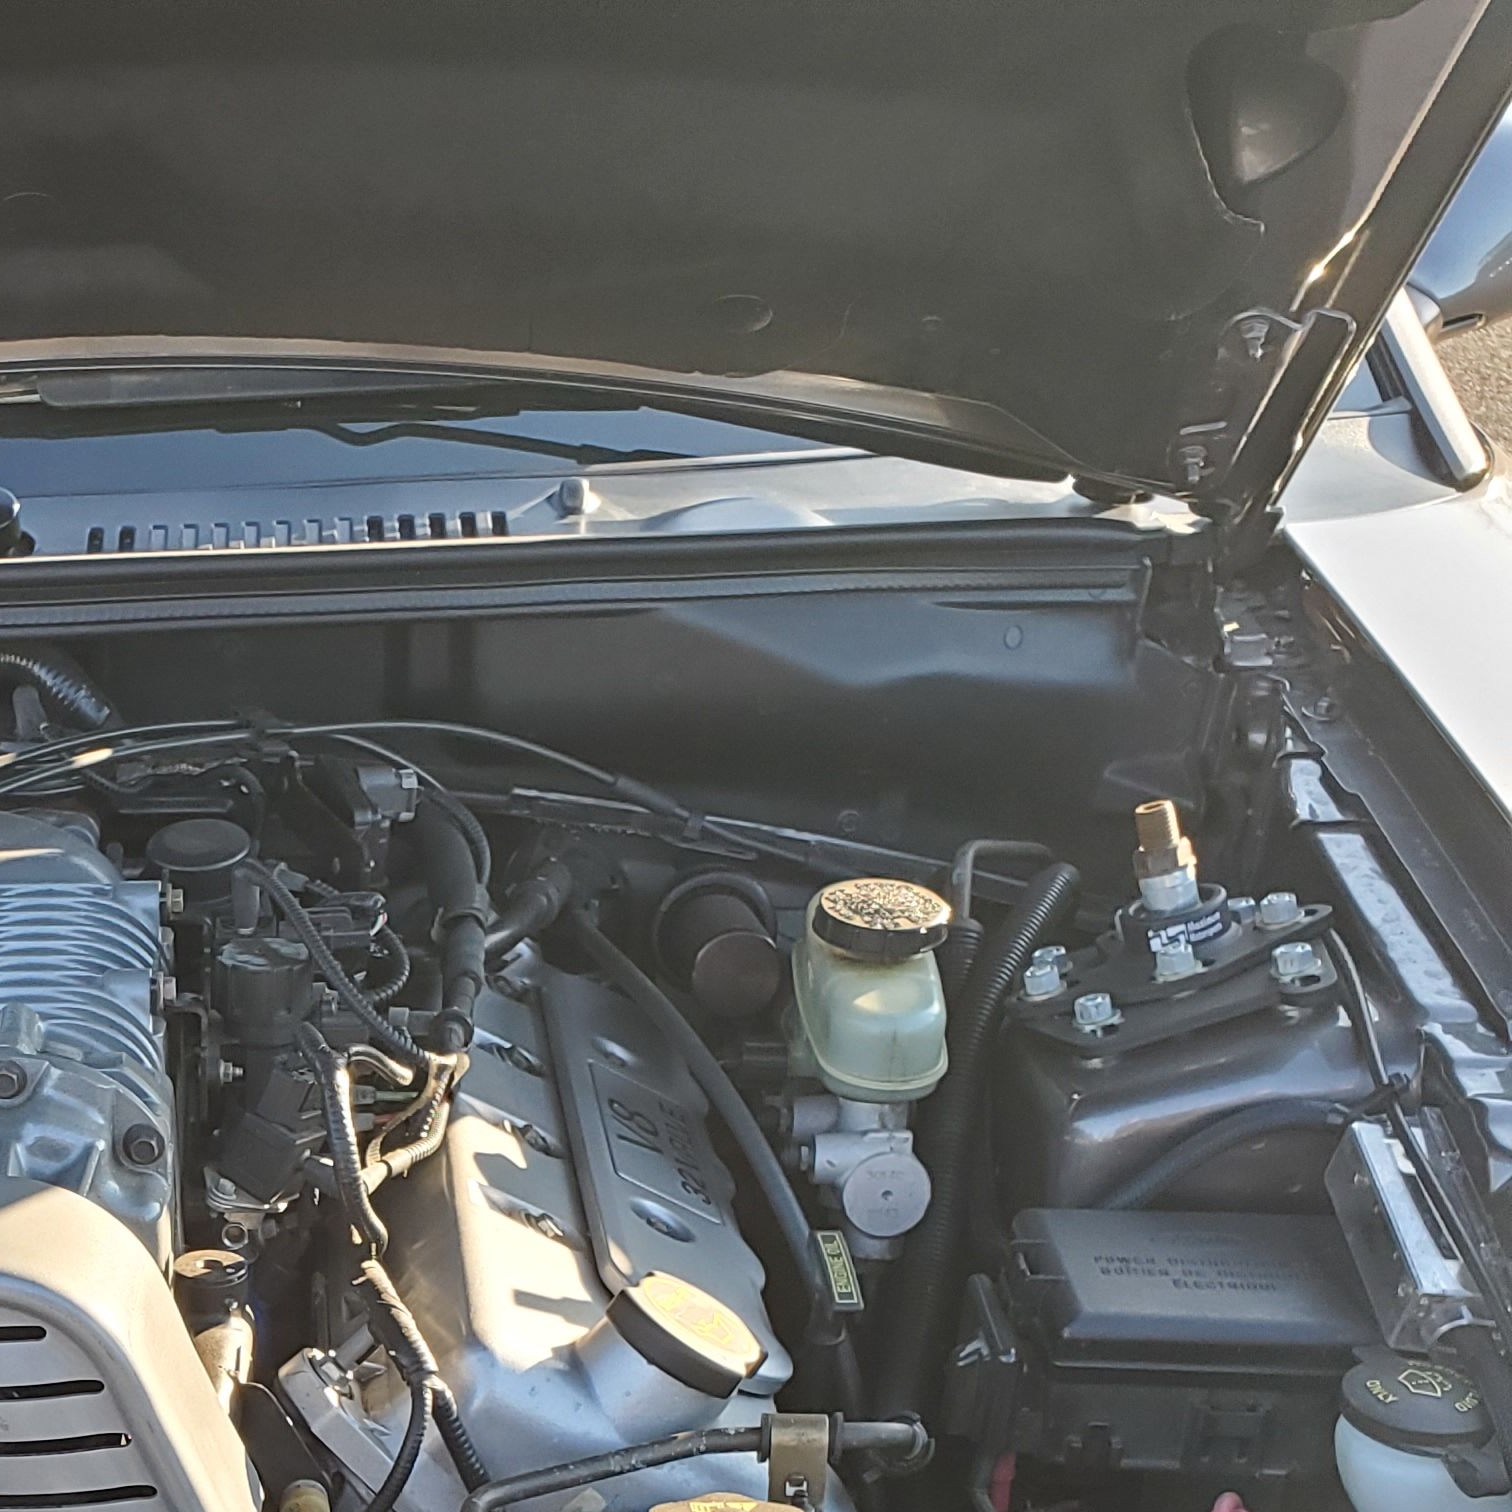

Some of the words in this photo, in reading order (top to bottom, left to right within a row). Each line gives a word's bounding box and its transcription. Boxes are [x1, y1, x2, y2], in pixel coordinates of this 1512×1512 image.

[607, 1098, 665, 1155] V8
[823, 1239, 841, 1256] OIL
[829, 1254, 852, 1293] ENGINE
[1365, 1379, 1399, 1404] ONLY
